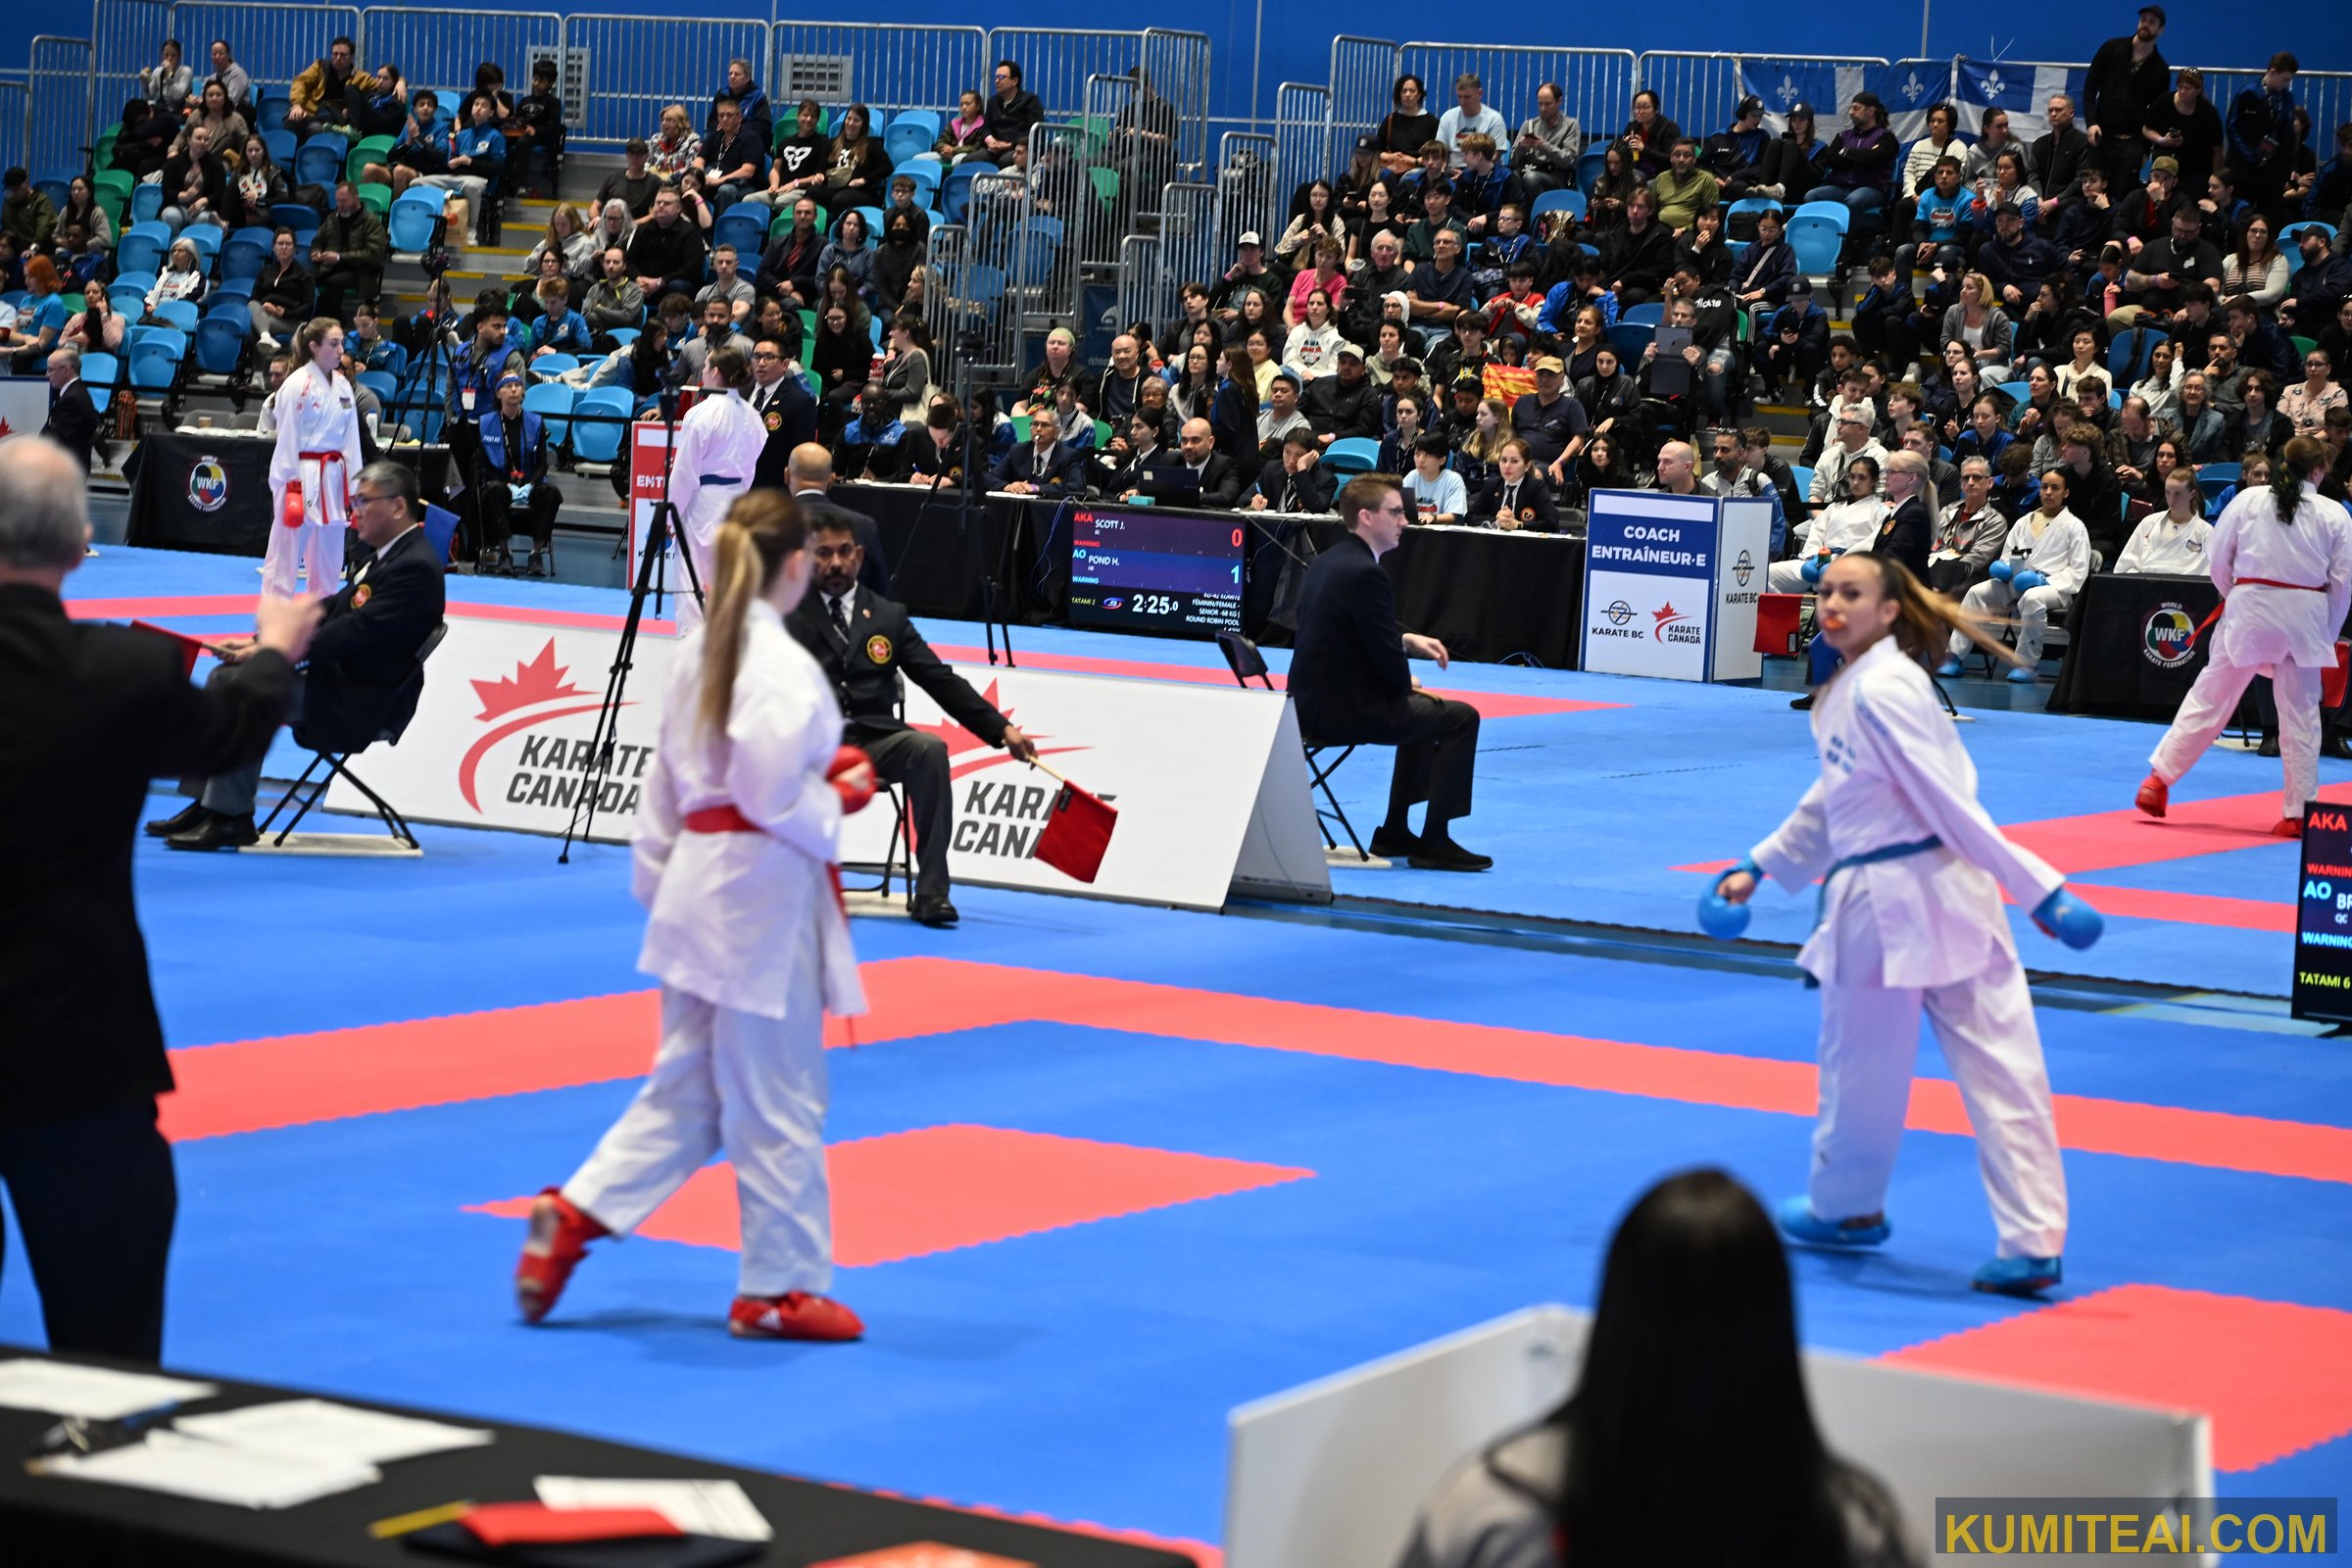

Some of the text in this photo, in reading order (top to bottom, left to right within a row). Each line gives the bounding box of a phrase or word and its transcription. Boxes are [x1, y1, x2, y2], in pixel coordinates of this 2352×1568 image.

[196, 476, 220, 490] WKF
[637, 475, 665, 488] ENT
[1074, 512, 1093, 523] AKA
[1095, 519, 1119, 529] SCOTT
[1231, 528, 1242, 547] 0
[1624, 526, 1680, 542] COACH
[1073, 548, 1086, 559] AO
[1088, 555, 1111, 565] POND
[1592, 545, 1706, 567] ENTRAÎNEUR·E
[1072, 576, 1099, 584] WARNING
[1231, 565, 1240, 584] 1
[1132, 594, 1178, 615] 2:25.0
[1725, 592, 1757, 604] KARATE BC
[1186, 615, 1205, 623] ROUND
[1592, 627, 1644, 639] KARATE BC
[1668, 624, 1701, 636] KARATE
[2155, 628, 2186, 642] WKF
[1667, 634, 1701, 645] CANADA
[2143, 648, 2162, 666] KARATE
[518, 735, 656, 778] KARATE
[506, 772, 641, 815] CANADA
[2308, 811, 2348, 832] AKA
[2307, 863, 2352, 878] WARNIN
[2303, 880, 2332, 900] AO
[2335, 913, 2348, 924] QC
[2299, 972, 2351, 989] TATAMI 6
